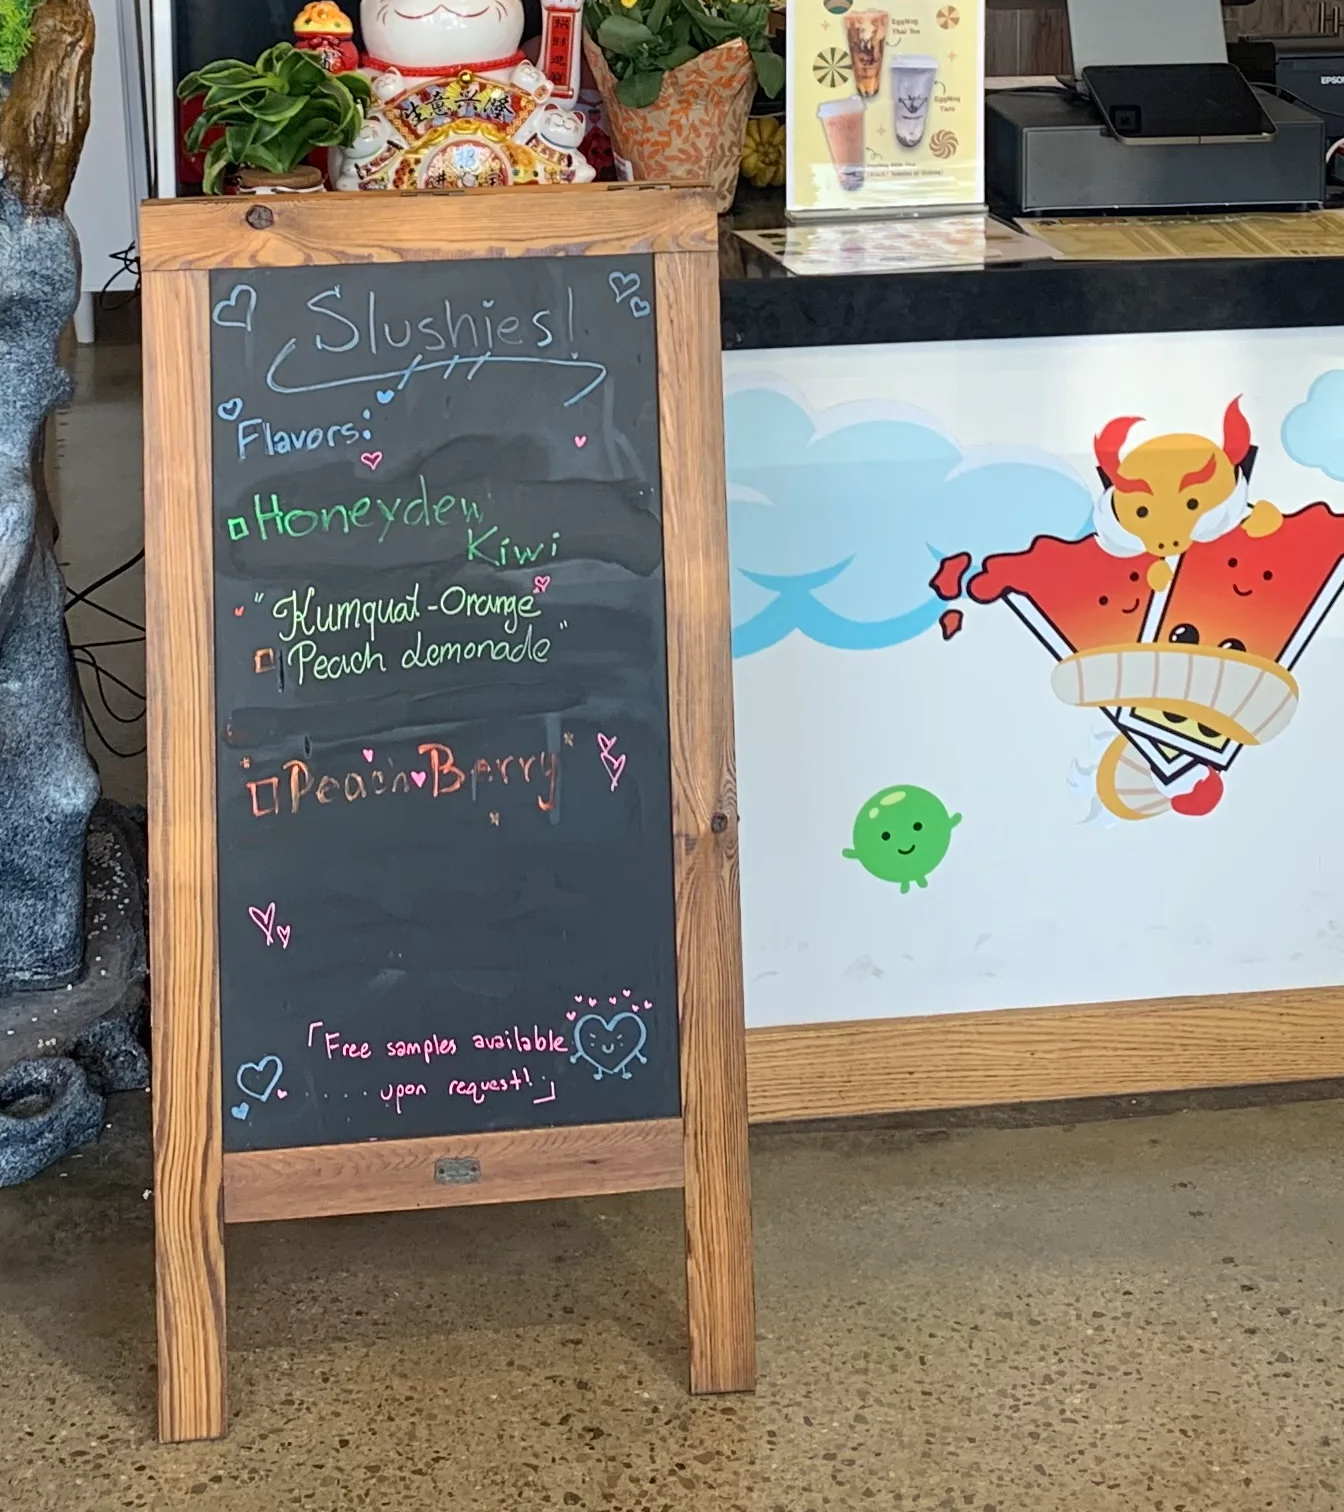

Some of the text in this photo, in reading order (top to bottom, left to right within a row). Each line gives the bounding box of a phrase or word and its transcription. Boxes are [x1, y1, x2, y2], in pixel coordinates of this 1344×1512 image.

[307, 285, 580, 359] Slushies!
[237, 409, 372, 460] Flavors:
[467, 526, 560, 566] Kiwi
[288, 640, 386, 684] Peach
[387, 1034, 457, 1064] samples
[472, 1024, 568, 1052] available
[380, 1083, 427, 1114] upon
